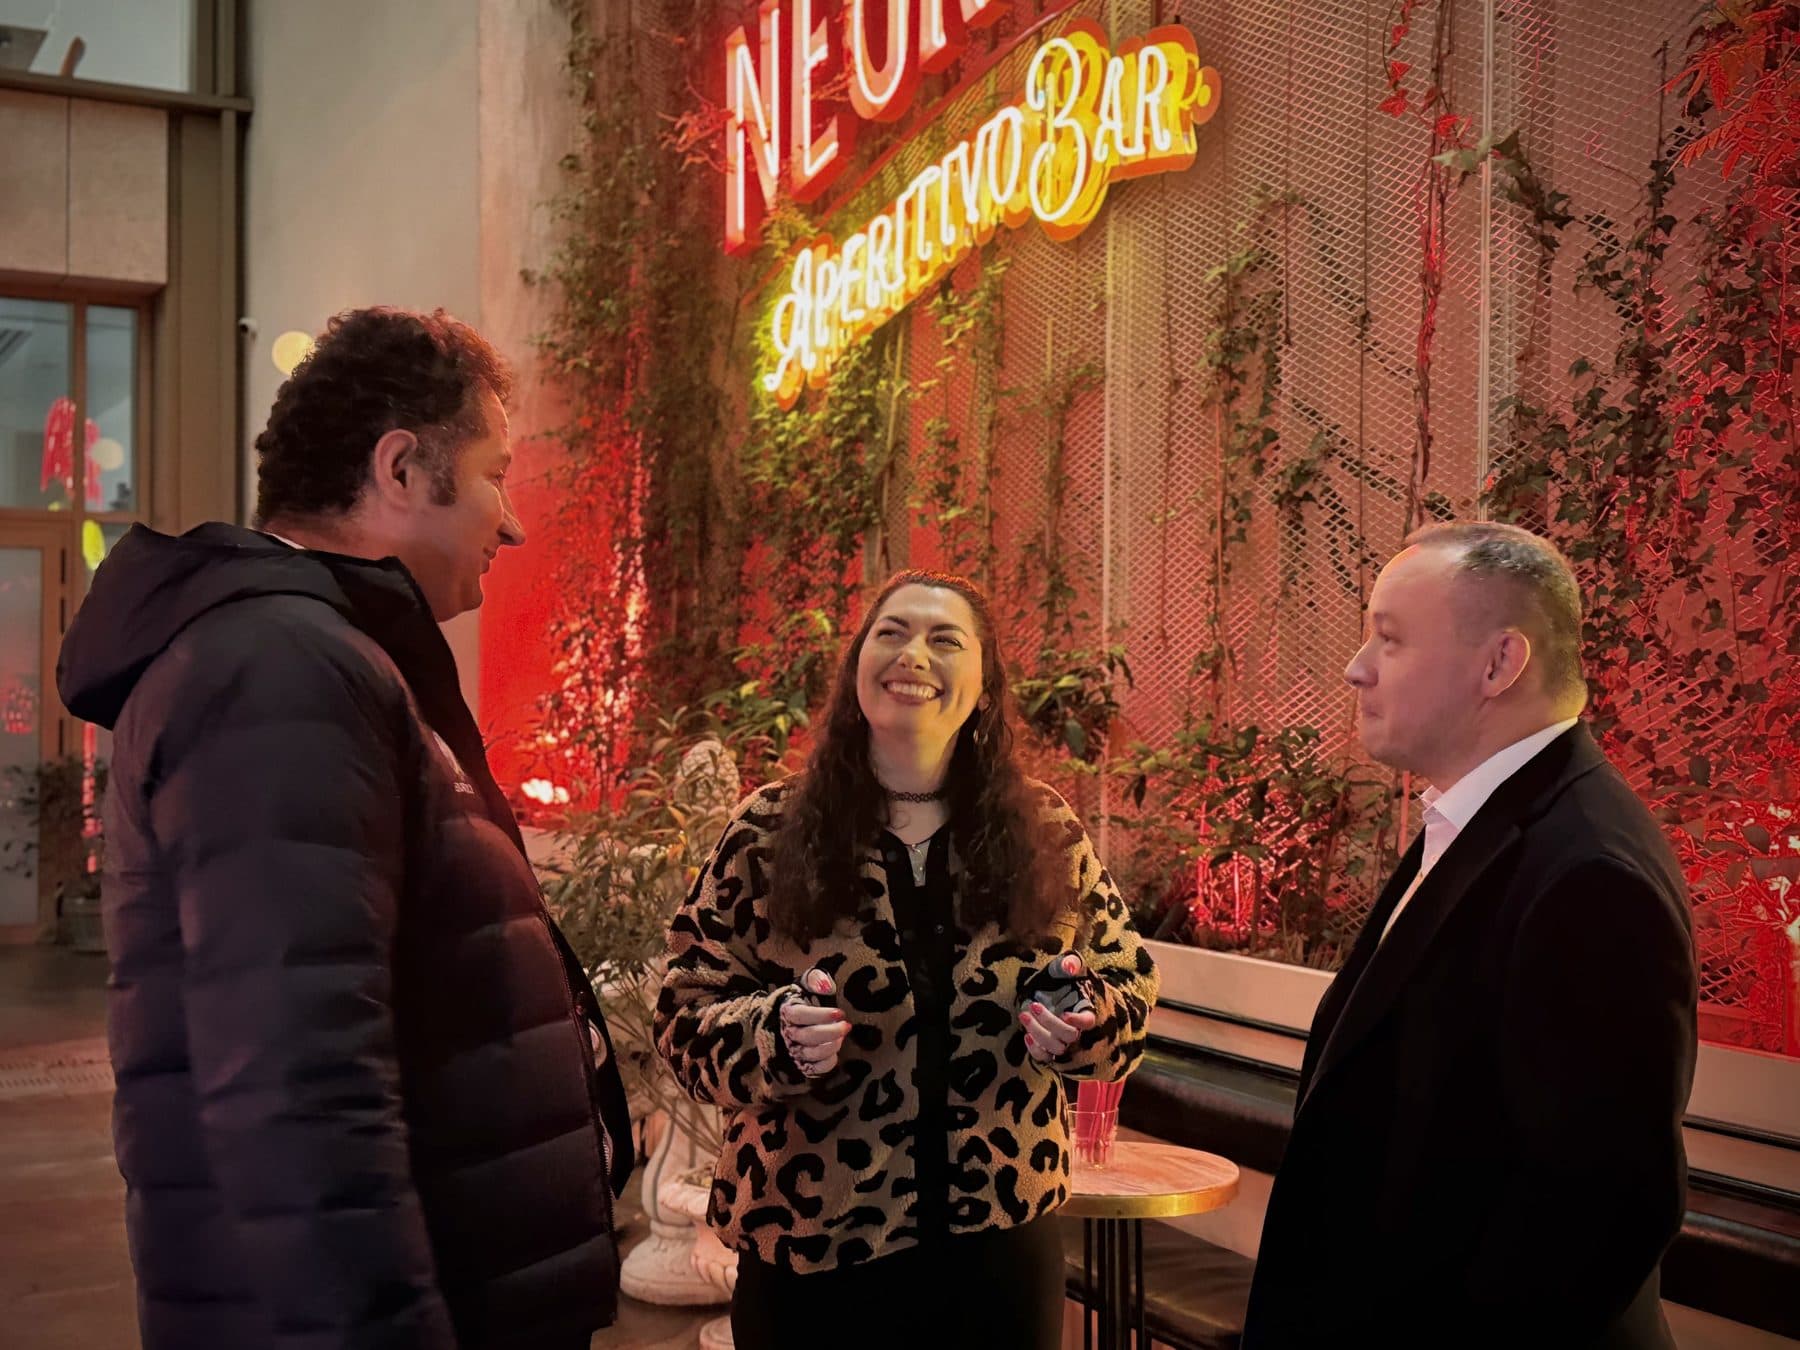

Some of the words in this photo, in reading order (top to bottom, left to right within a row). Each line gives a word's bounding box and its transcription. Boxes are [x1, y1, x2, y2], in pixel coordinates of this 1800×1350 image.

[726, 0, 993, 254] NEO
[763, 104, 1026, 395] APERITIVO
[1026, 34, 1188, 224] BAR
